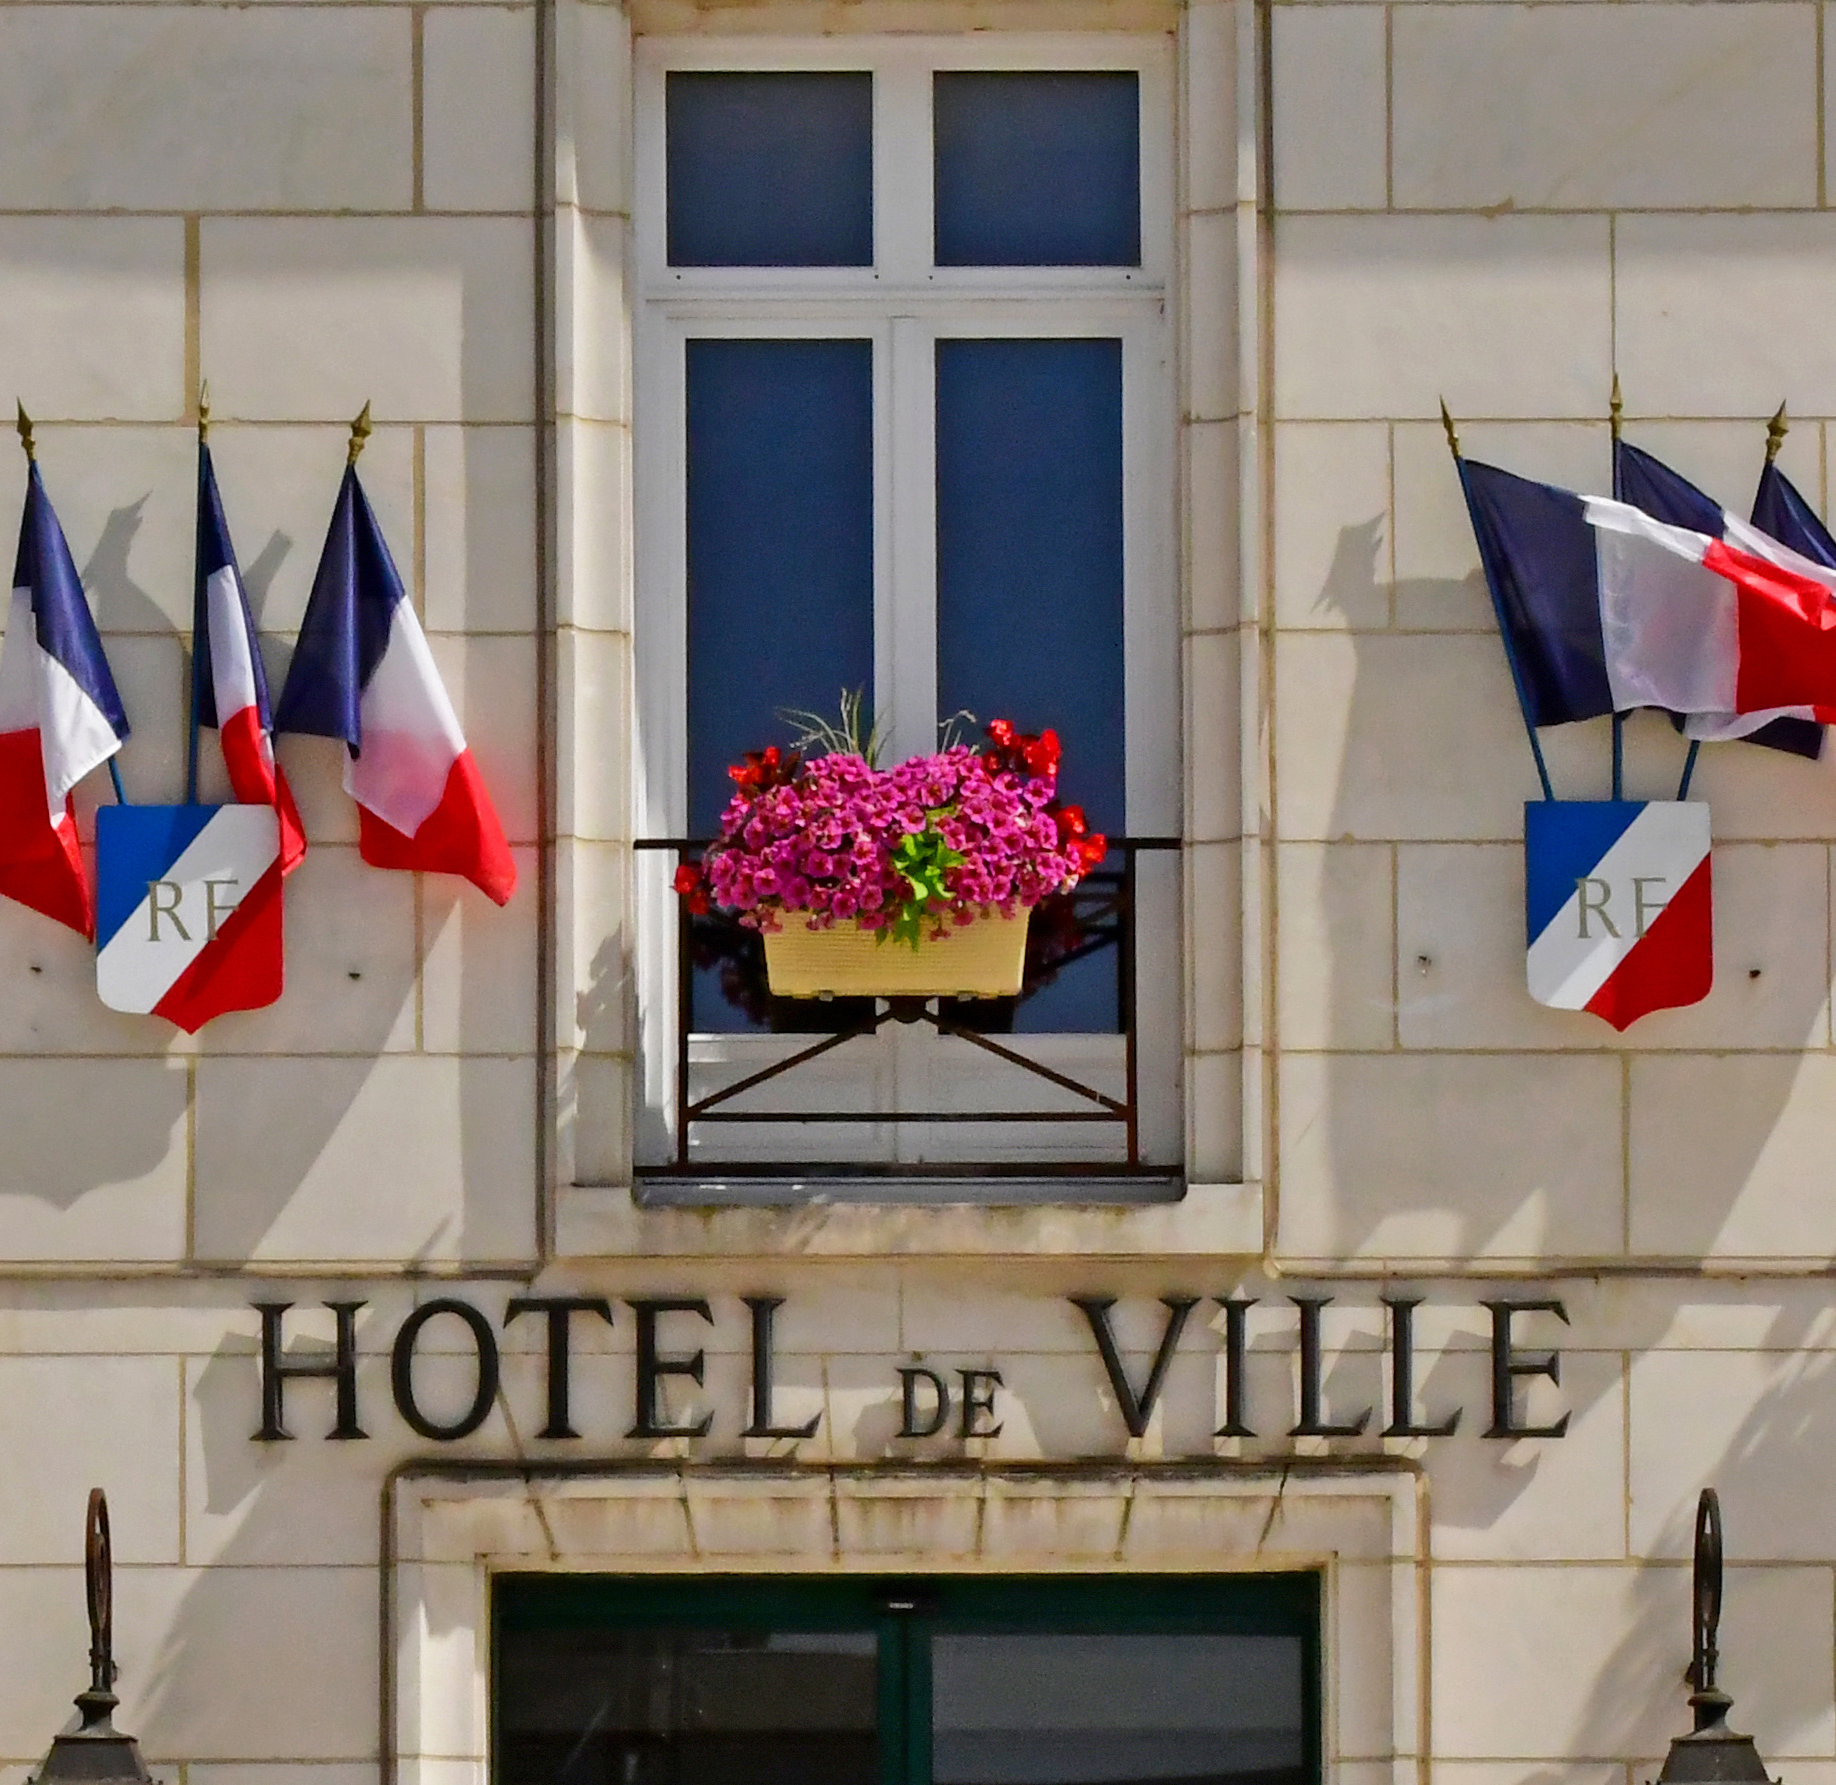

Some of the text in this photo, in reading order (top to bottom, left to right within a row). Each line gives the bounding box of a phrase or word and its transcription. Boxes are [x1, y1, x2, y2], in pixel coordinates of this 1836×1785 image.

[147, 878, 239, 942] RF
[1575, 876, 1667, 939] RF
[250, 1296, 1576, 1442] HOTEL DE VILLE
